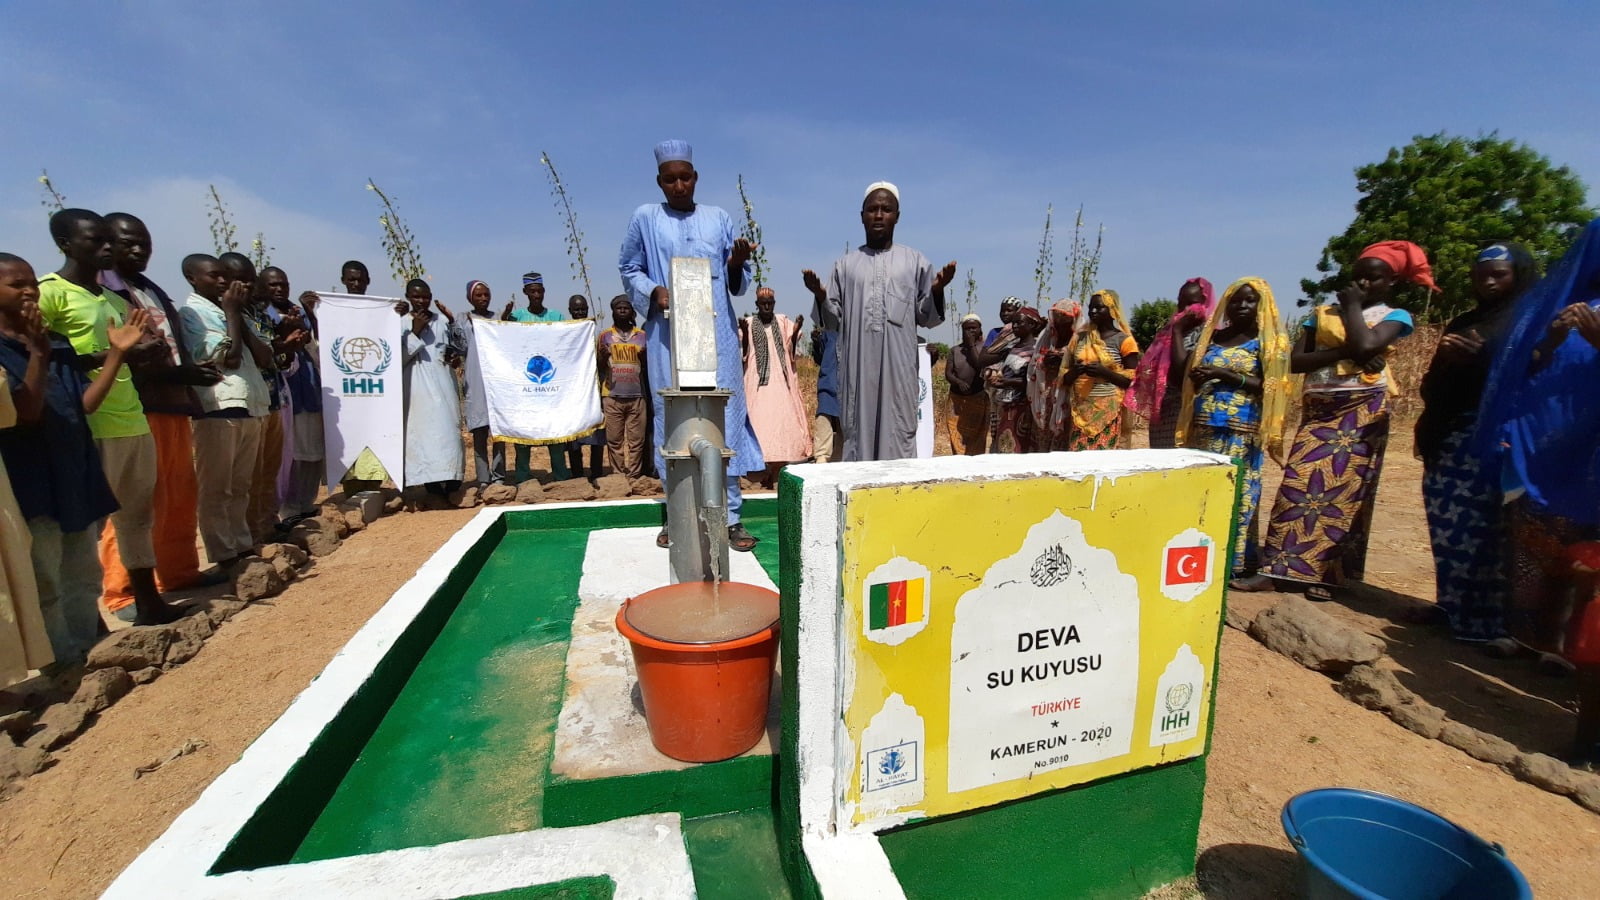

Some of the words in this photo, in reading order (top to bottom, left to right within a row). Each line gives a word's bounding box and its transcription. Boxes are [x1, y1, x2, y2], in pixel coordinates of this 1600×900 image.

[1017, 624, 1081, 653] DEVA
[987, 669, 1014, 689] SU
[1021, 654, 1102, 683] KUYUSU
[1031, 697, 1081, 717] TÜRKİYE
[1161, 711, 1190, 732] IHH
[990, 735, 1067, 761] KAMERUN
[1081, 726, 1112, 743] 2020
[1034, 754, 1069, 769] No.9010
